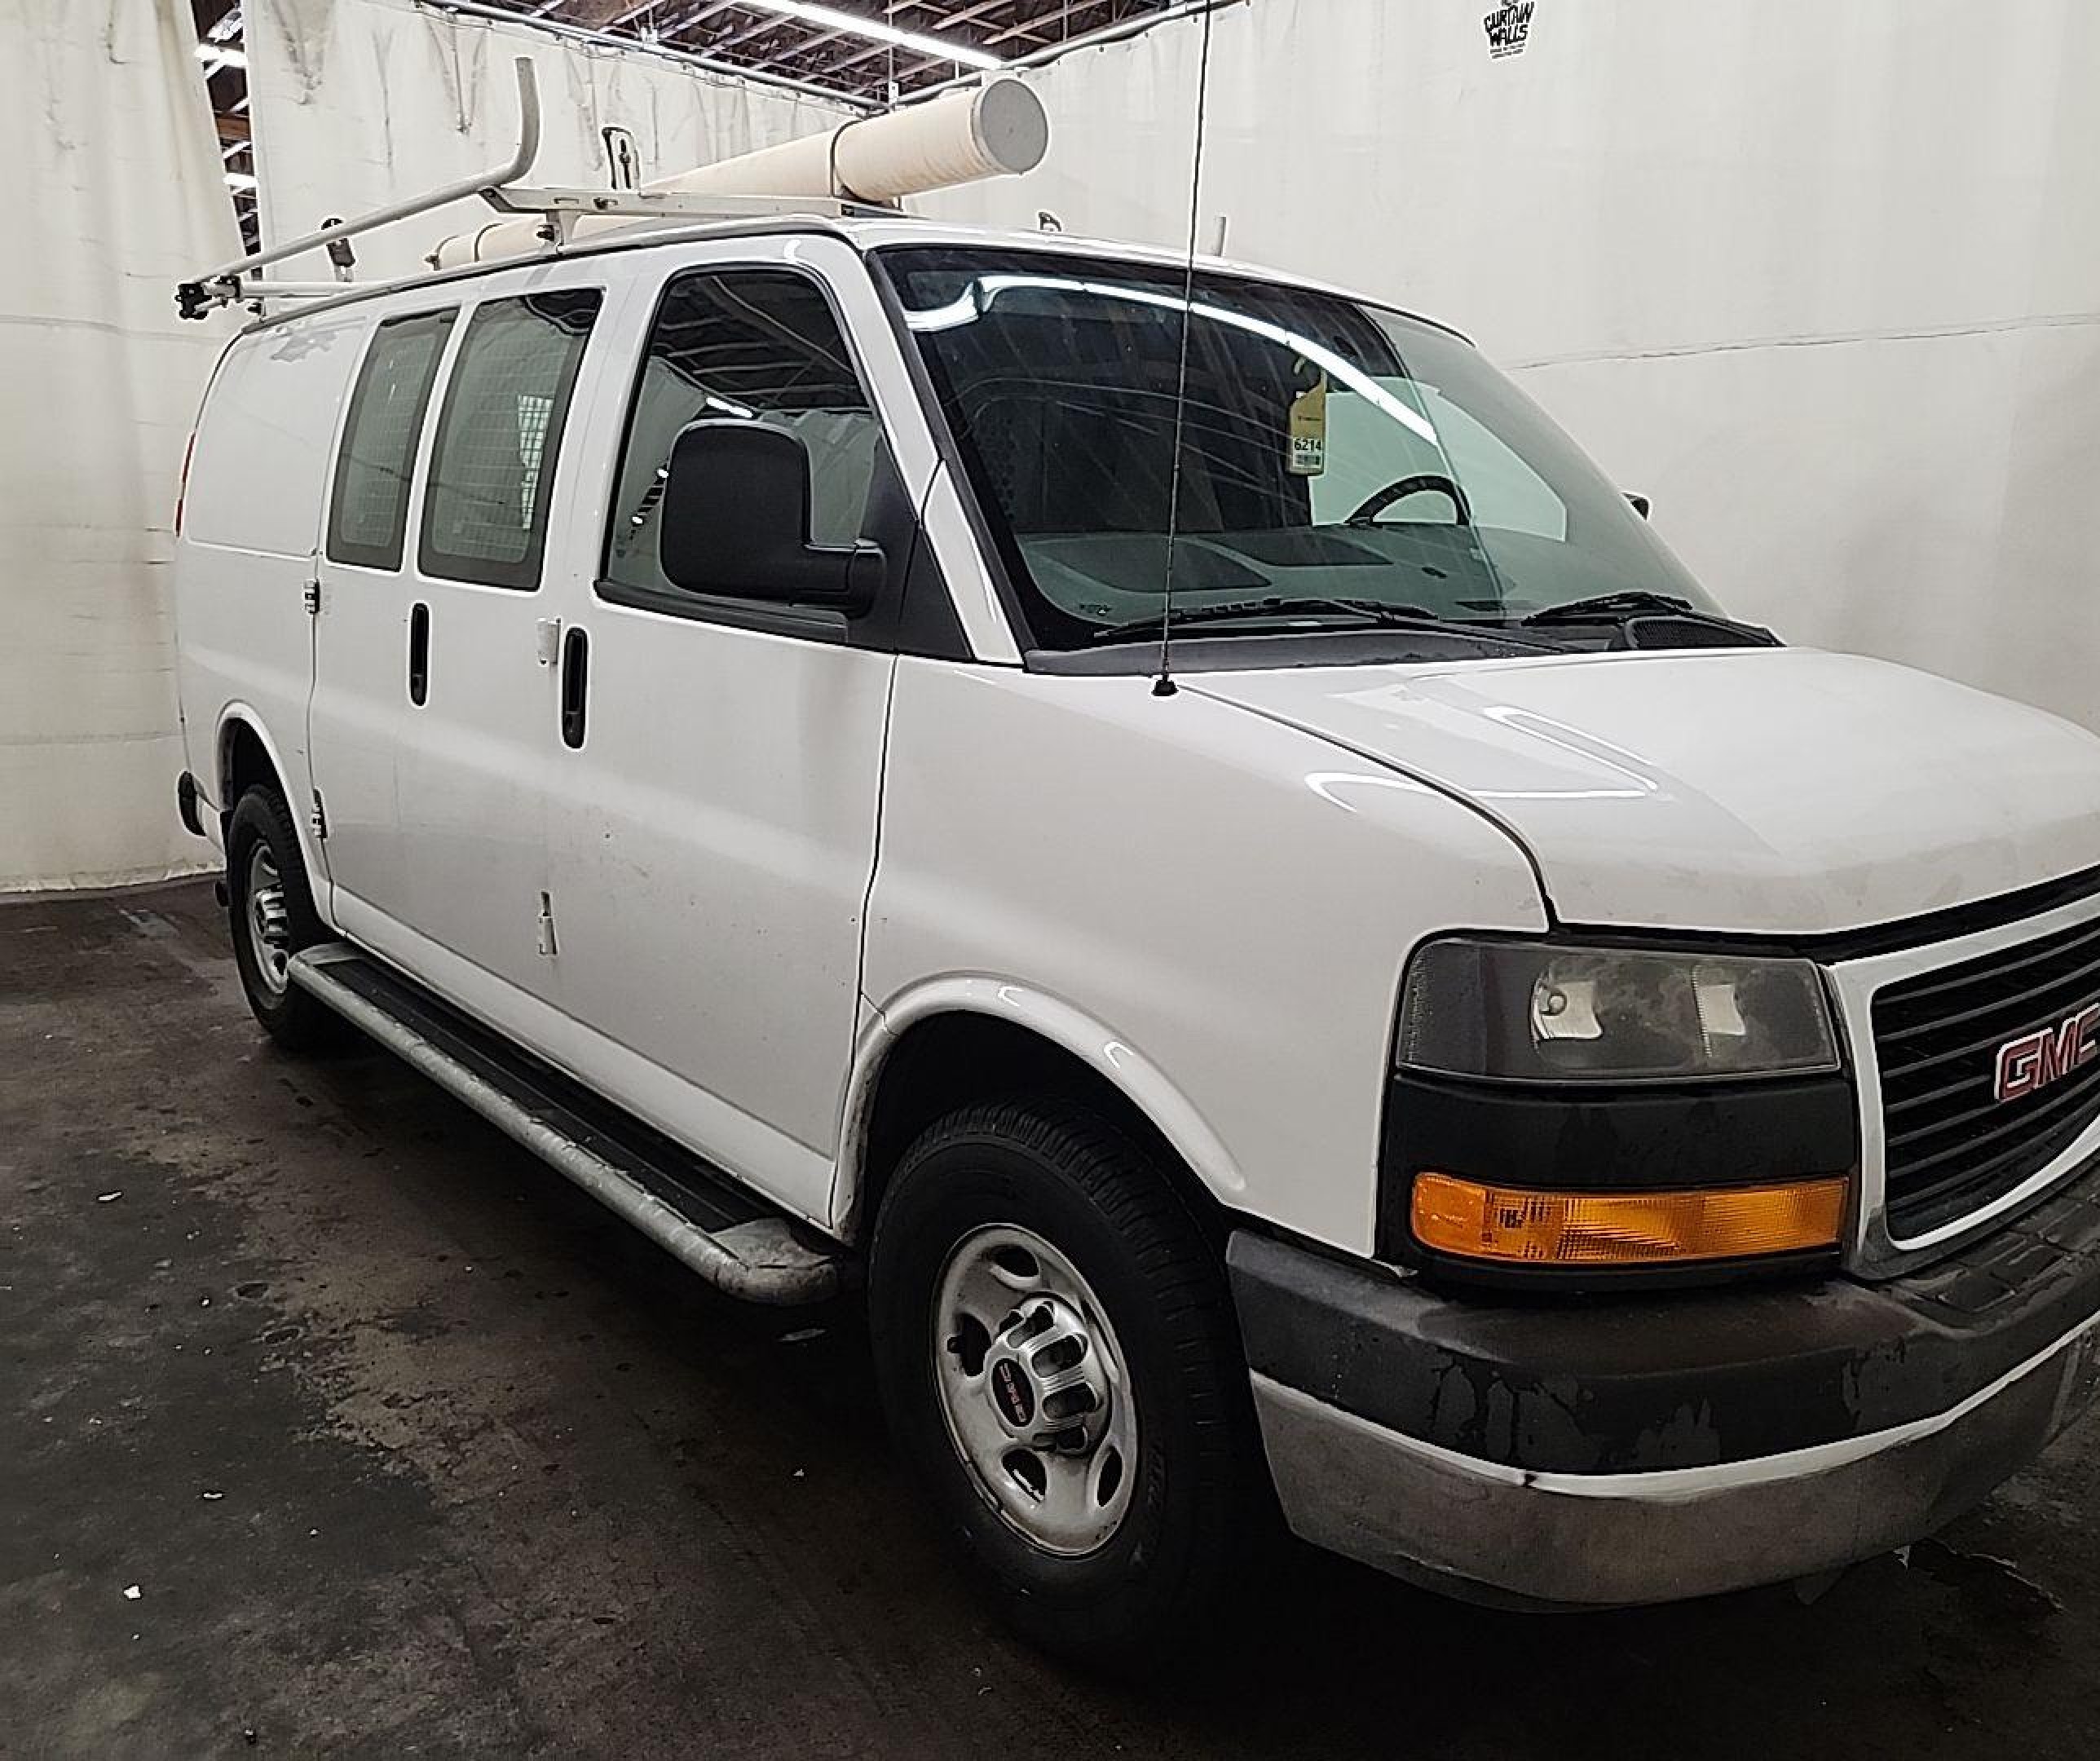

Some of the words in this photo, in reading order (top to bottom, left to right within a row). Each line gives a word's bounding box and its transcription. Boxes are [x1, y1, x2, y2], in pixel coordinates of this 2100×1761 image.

[1484, 2, 1534, 28] CURTAIN
[1486, 24, 1528, 46] WALLS
[1295, 439, 1321, 452] 6214
[1994, 1003, 2100, 1103] GMC
